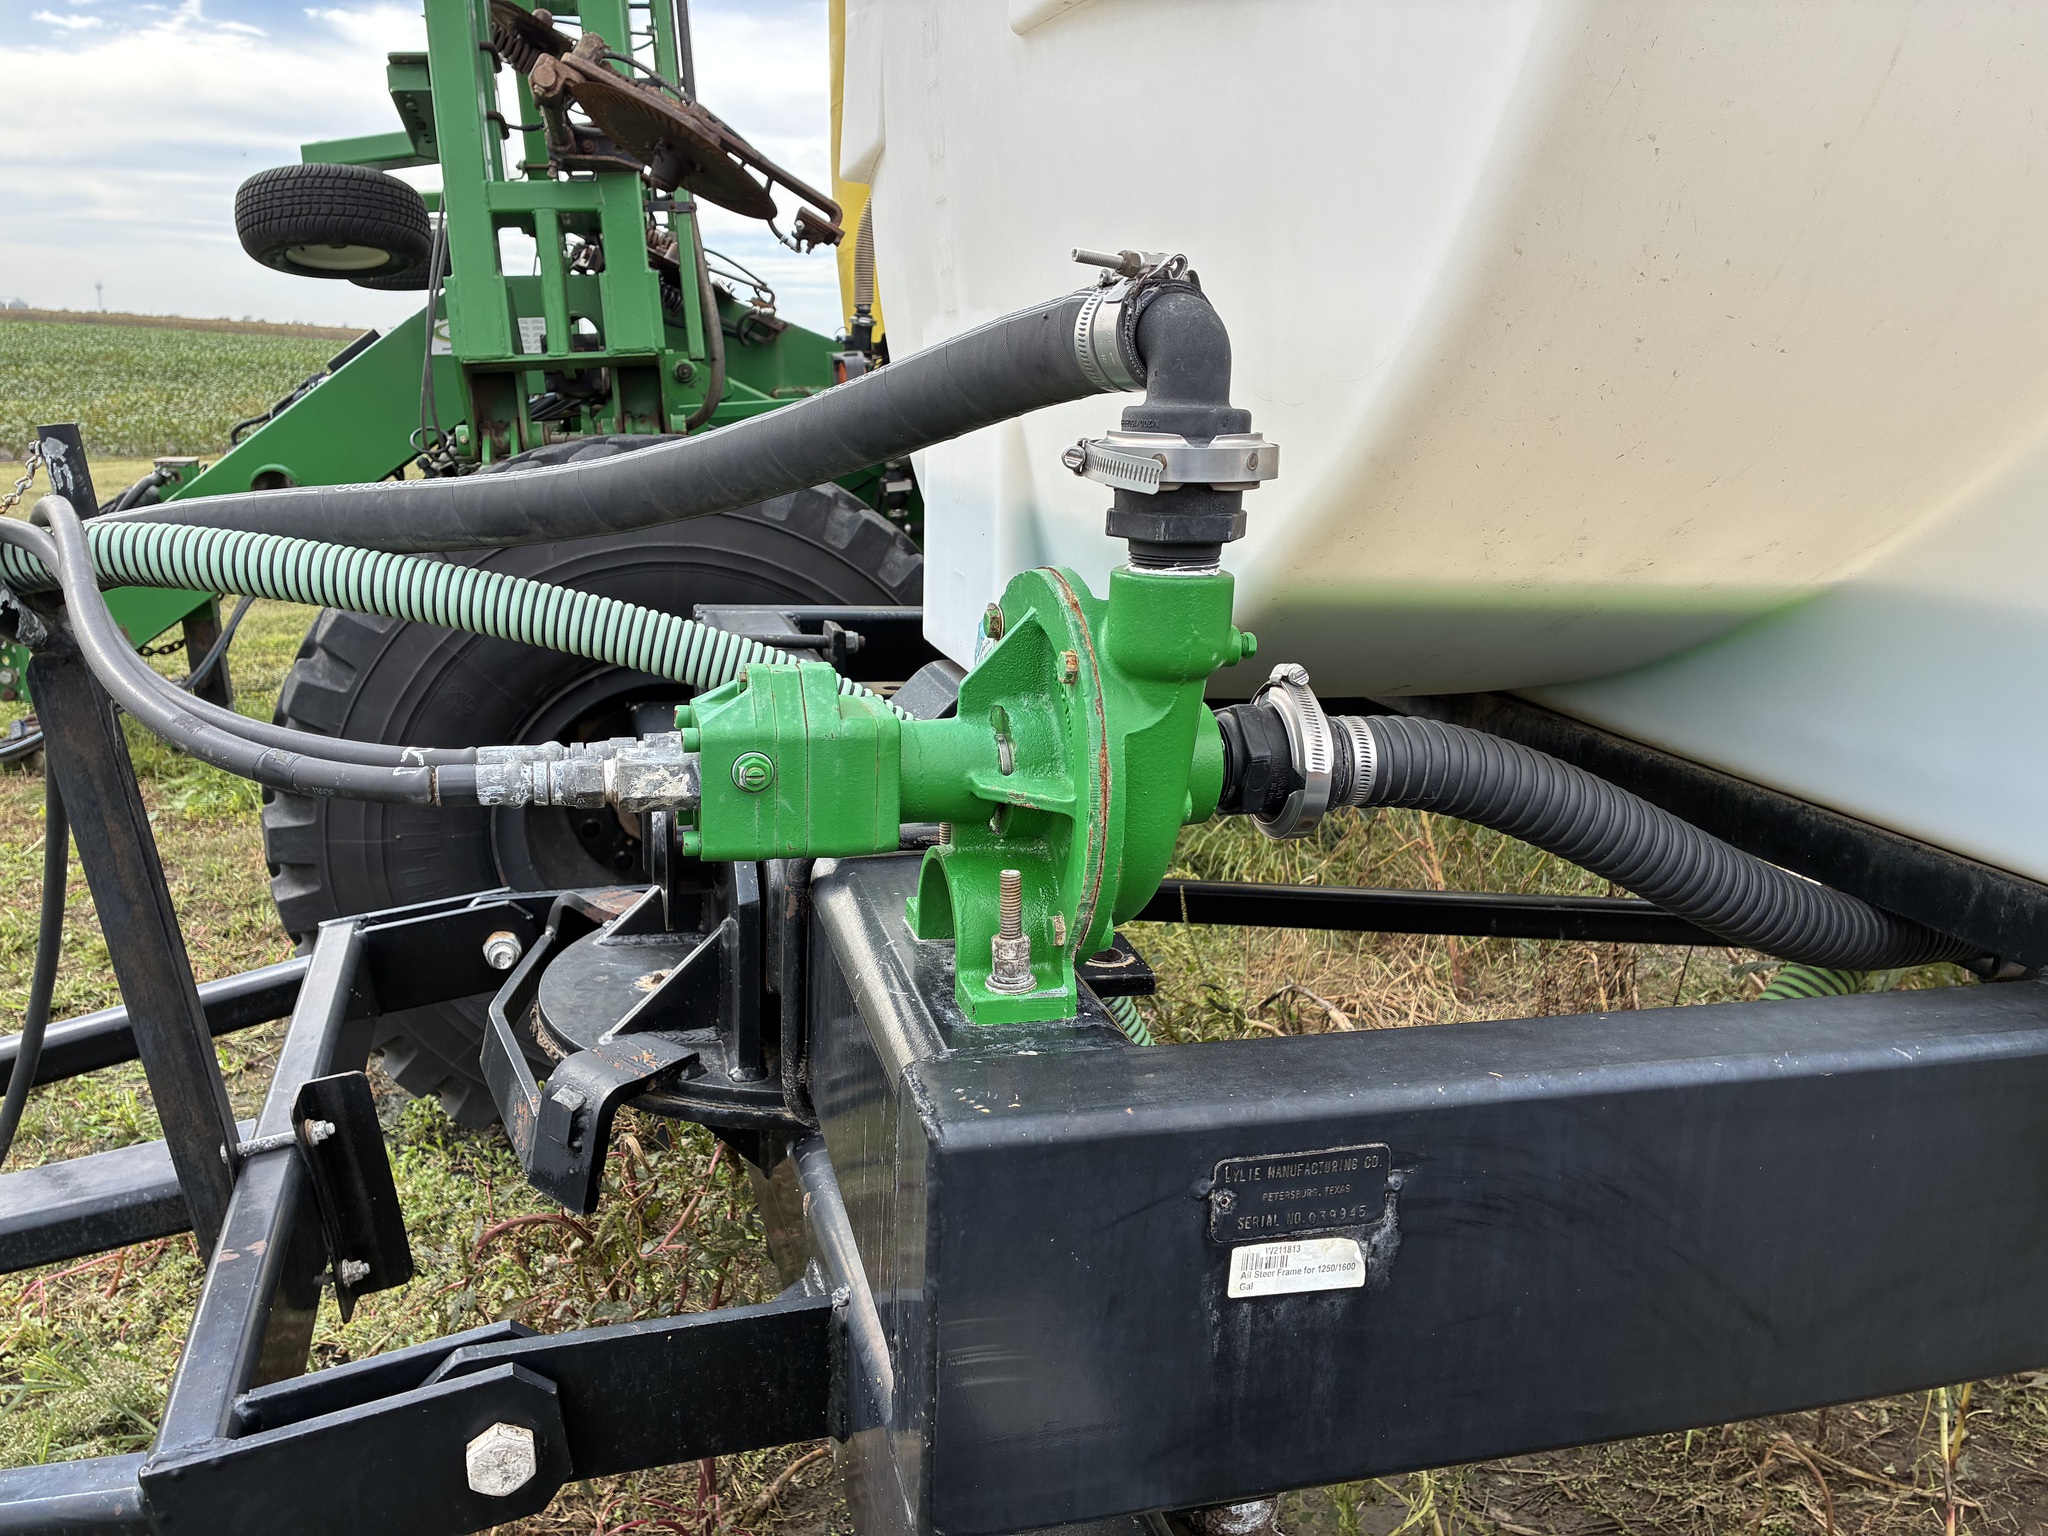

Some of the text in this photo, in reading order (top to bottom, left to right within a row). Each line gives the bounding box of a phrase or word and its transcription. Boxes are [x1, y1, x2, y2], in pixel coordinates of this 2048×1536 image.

[1267, 1157, 1358, 1180] MANUFACTURING
[1364, 1155, 1383, 1169] CO.
[1325, 1184, 1351, 1195] TEXAS
[1237, 1214, 1280, 1230] SERIAL
[1254, 1269, 1275, 1279] Steer
[1277, 1268, 1302, 1277] Frame
[1303, 1266, 1316, 1274] for
[1317, 1262, 1356, 1273] 1250/1600
[1239, 1282, 1254, 1291] Gal
